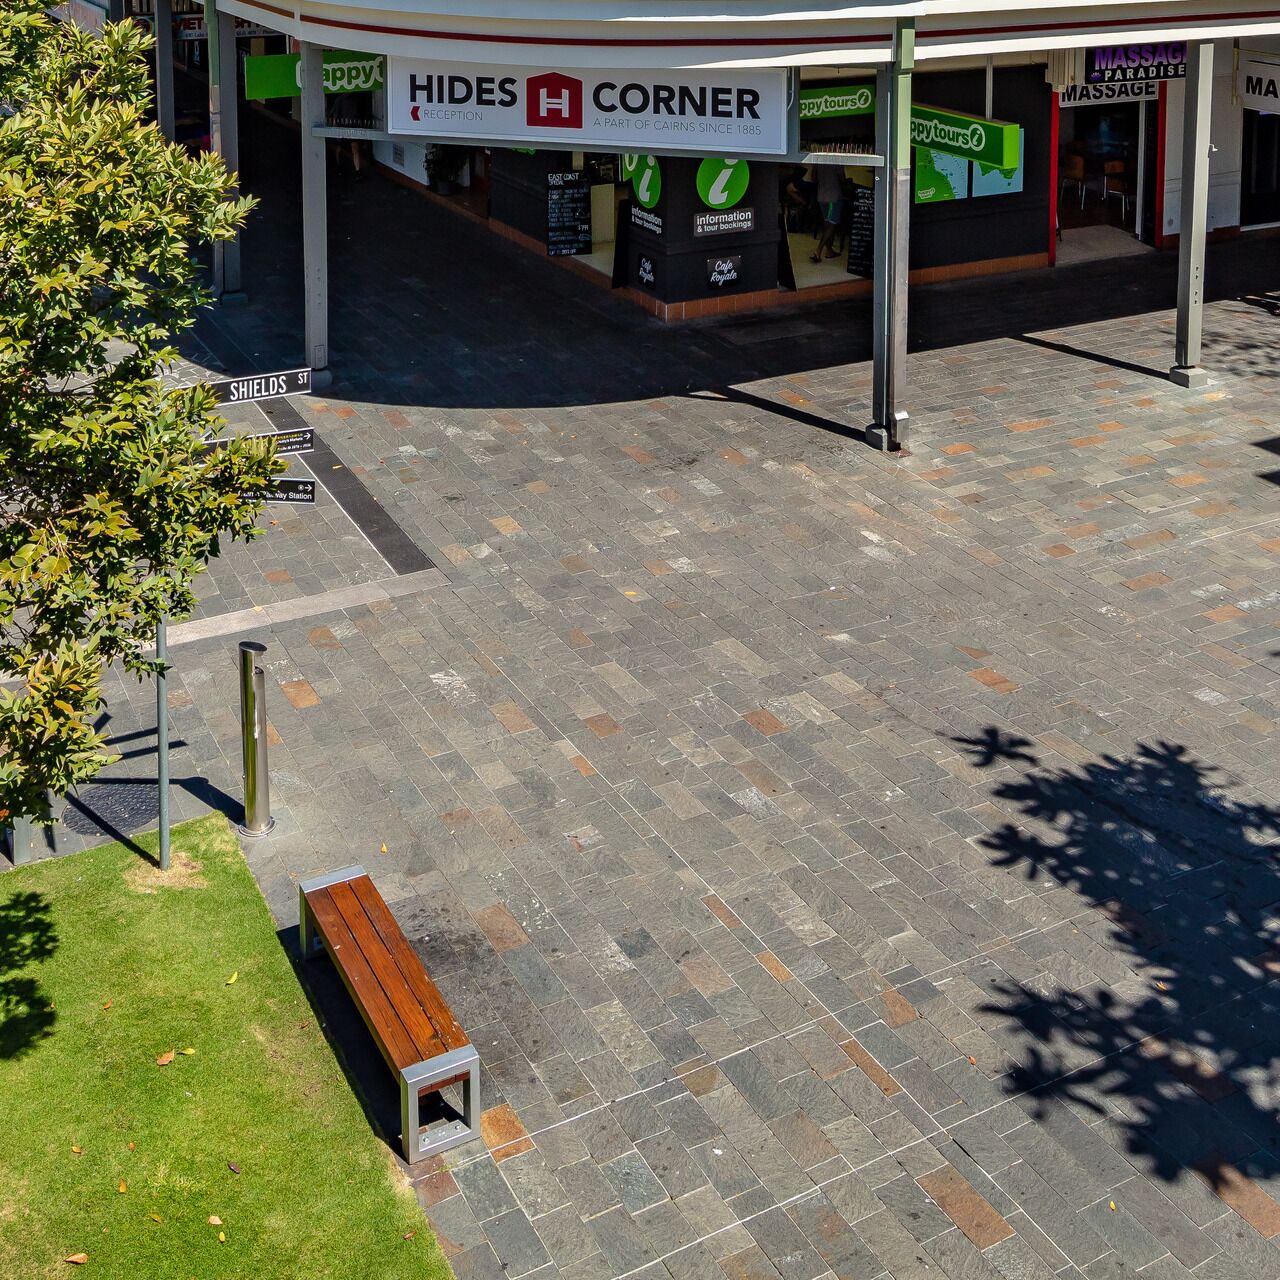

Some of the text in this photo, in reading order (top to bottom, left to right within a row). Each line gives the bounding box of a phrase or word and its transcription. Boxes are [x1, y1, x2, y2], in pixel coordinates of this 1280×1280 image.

[1104, 64, 1185, 81] PARADISE
[409, 74, 518, 108] HIDES
[592, 81, 761, 120] CORNER
[1061, 81, 1156, 102] MASSAGE
[423, 109, 483, 121] RECEPTION
[800, 101, 824, 114] ppy
[592, 117, 762, 136] A PART OF CAIRNS SINCE 1885
[911, 120, 933, 138] ppy
[548, 172, 580, 181] EAST COAST
[631, 205, 662, 226] information
[696, 210, 752, 225] information
[643, 219, 662, 235] bookings
[697, 220, 752, 233] & tour bookings
[715, 260, 733, 274] Cafe
[710, 270, 738, 286] Royale
[230, 372, 308, 401] SHIELDS ST
[288, 491, 313, 500] Station
